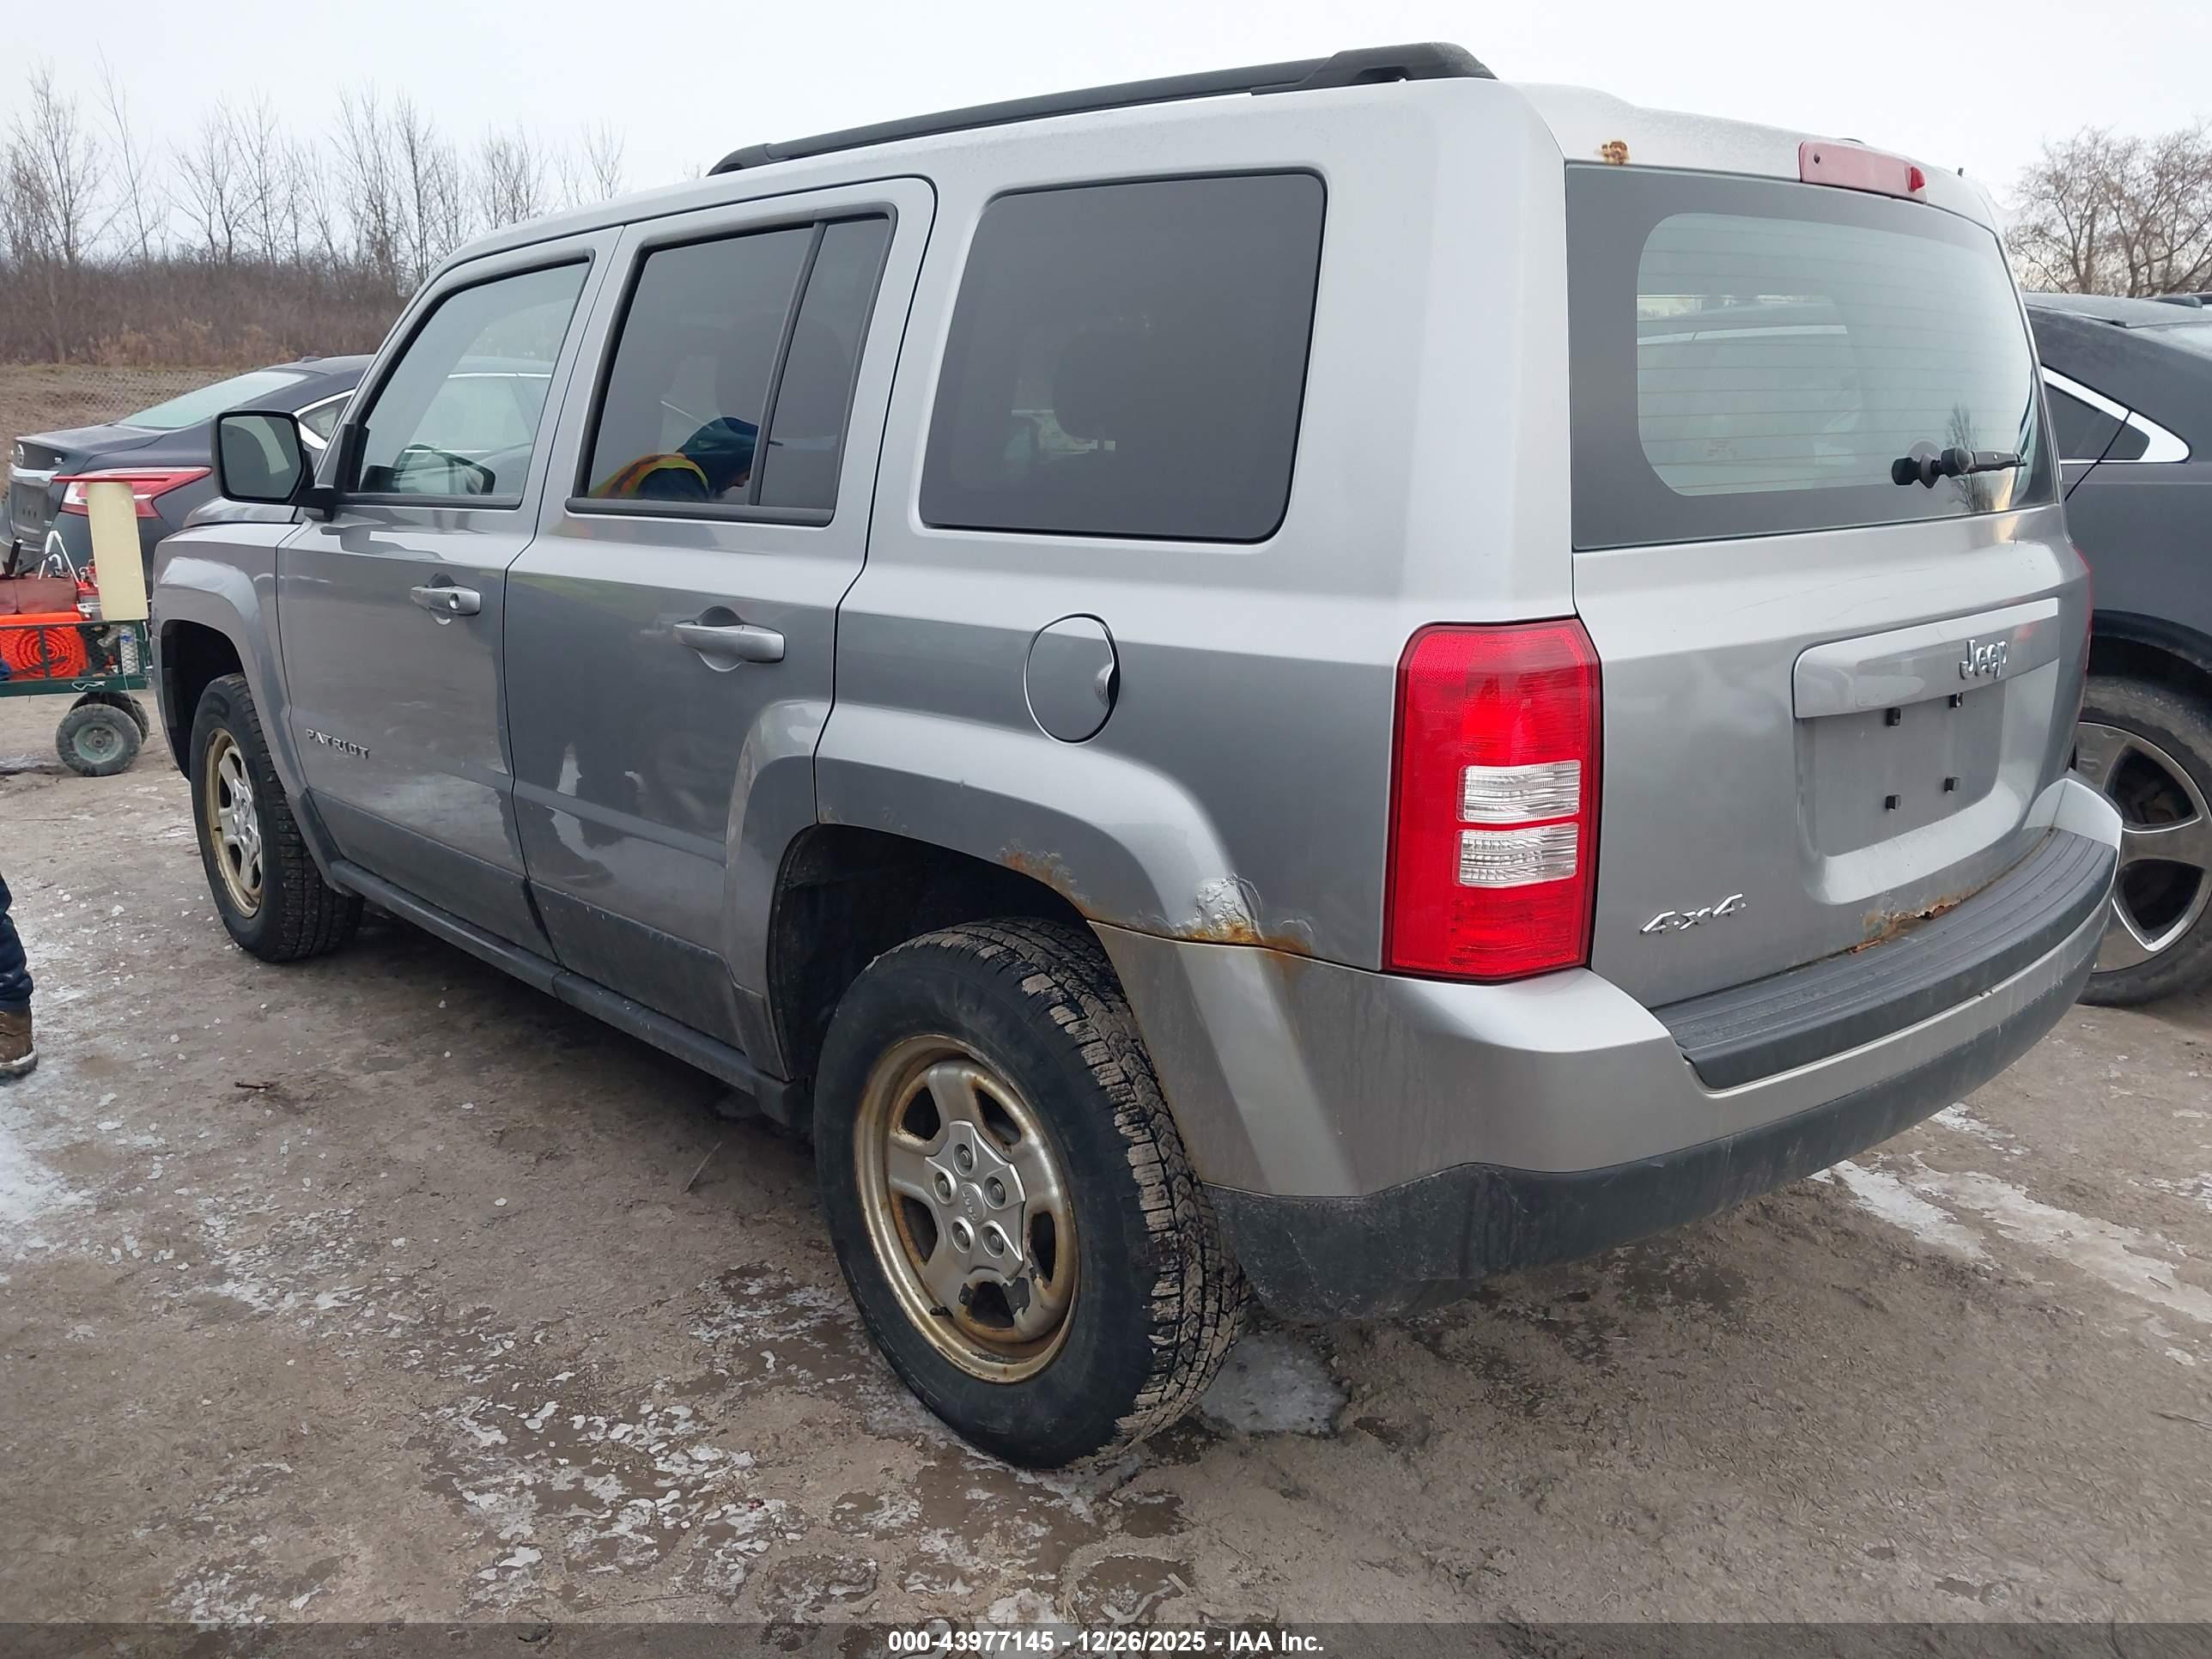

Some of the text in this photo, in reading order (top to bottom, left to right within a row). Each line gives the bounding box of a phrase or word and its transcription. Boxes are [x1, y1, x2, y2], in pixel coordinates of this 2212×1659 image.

[1959, 639, 2008, 680] Jeep
[305, 727, 370, 760] PATRIOT
[1639, 893, 1747, 935] 4x4
